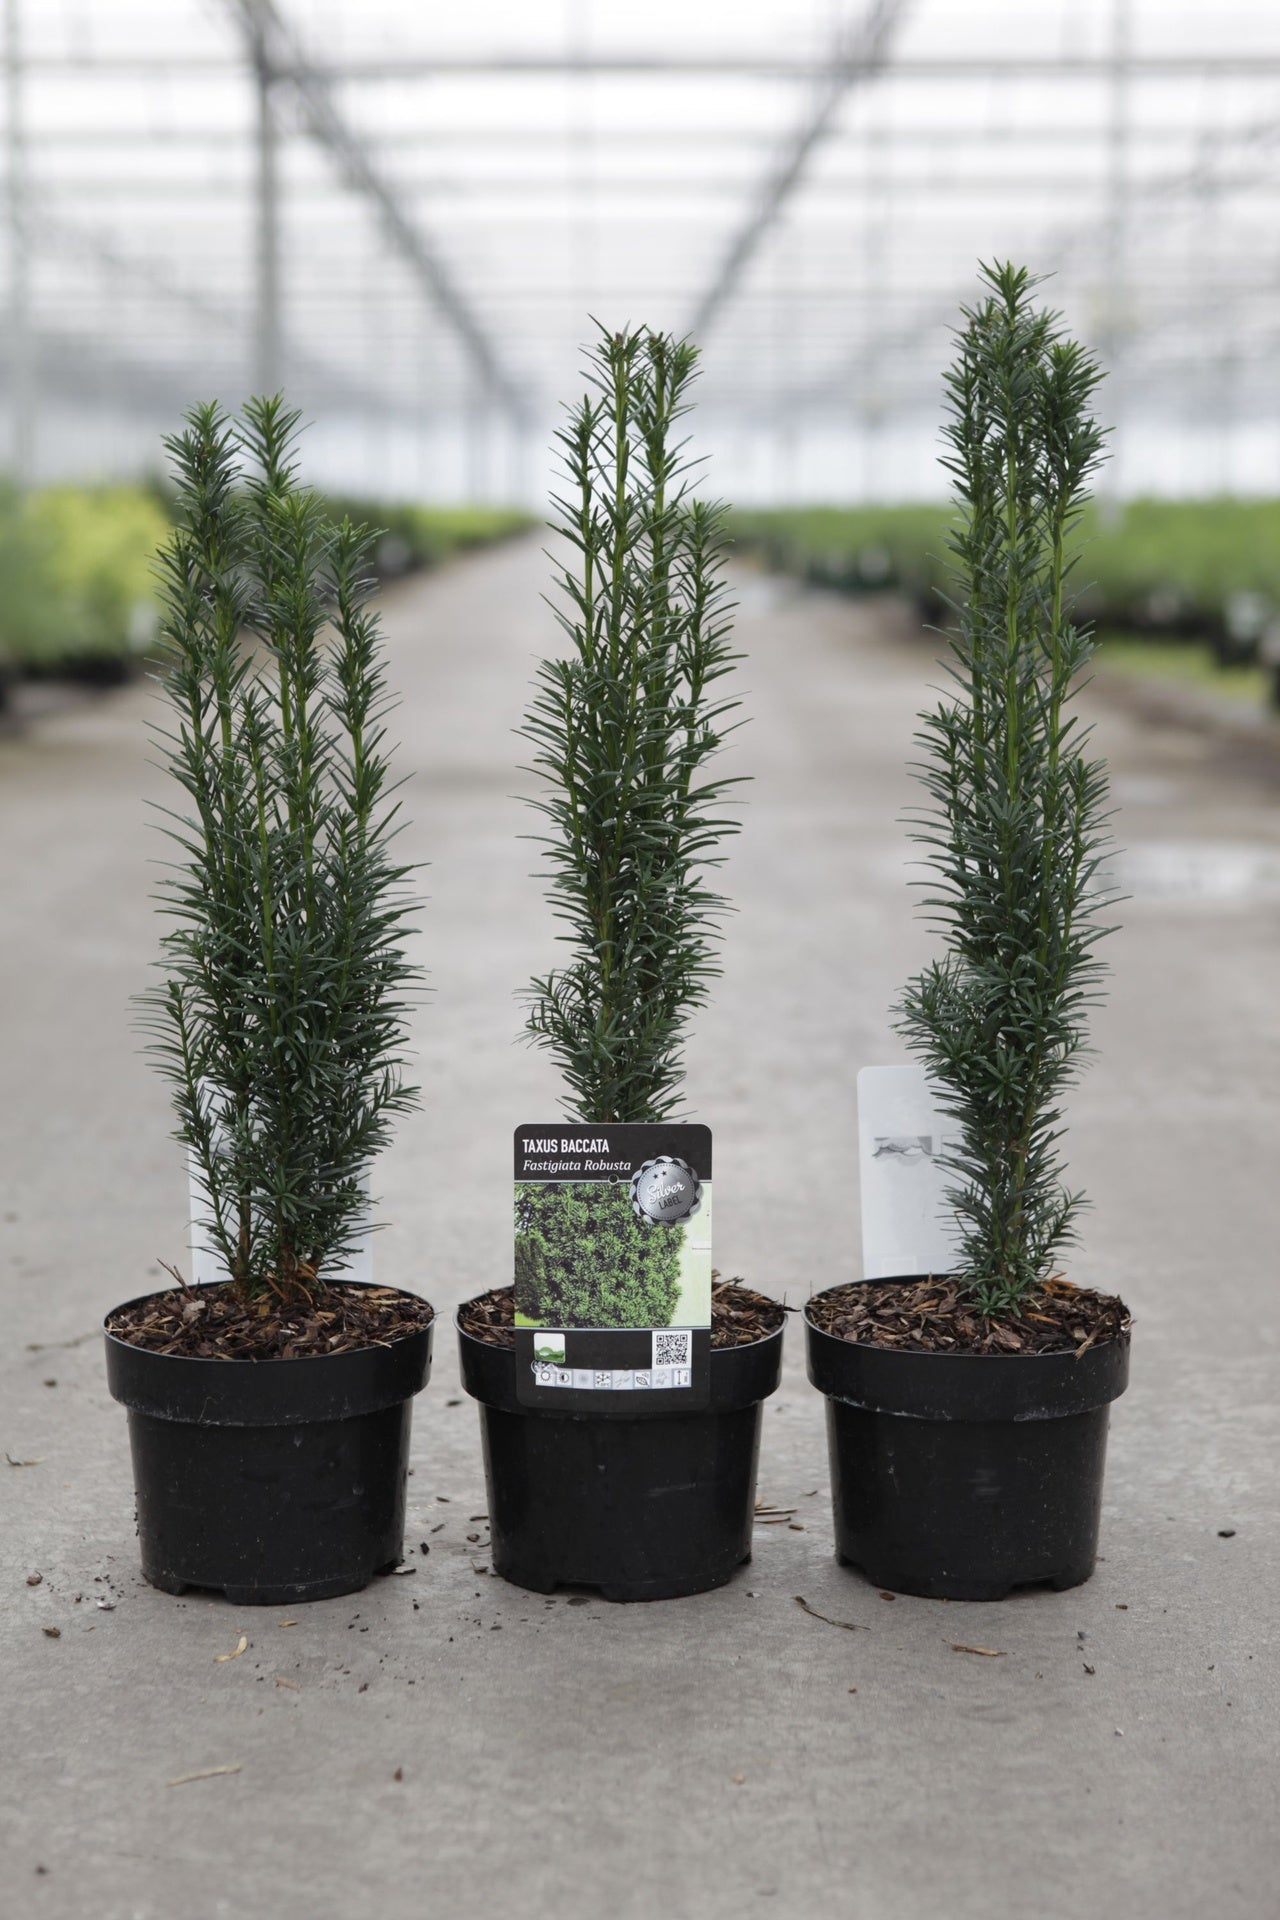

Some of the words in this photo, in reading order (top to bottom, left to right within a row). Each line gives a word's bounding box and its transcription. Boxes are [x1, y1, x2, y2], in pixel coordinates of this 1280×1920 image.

[522, 1139, 558, 1153] TAXUS
[561, 1139, 610, 1153] BACCATA
[522, 1159, 581, 1174] Fastigiata
[584, 1159, 632, 1171] Robusta
[647, 1181, 686, 1203] Silver
[658, 1195, 683, 1210] LABEL
